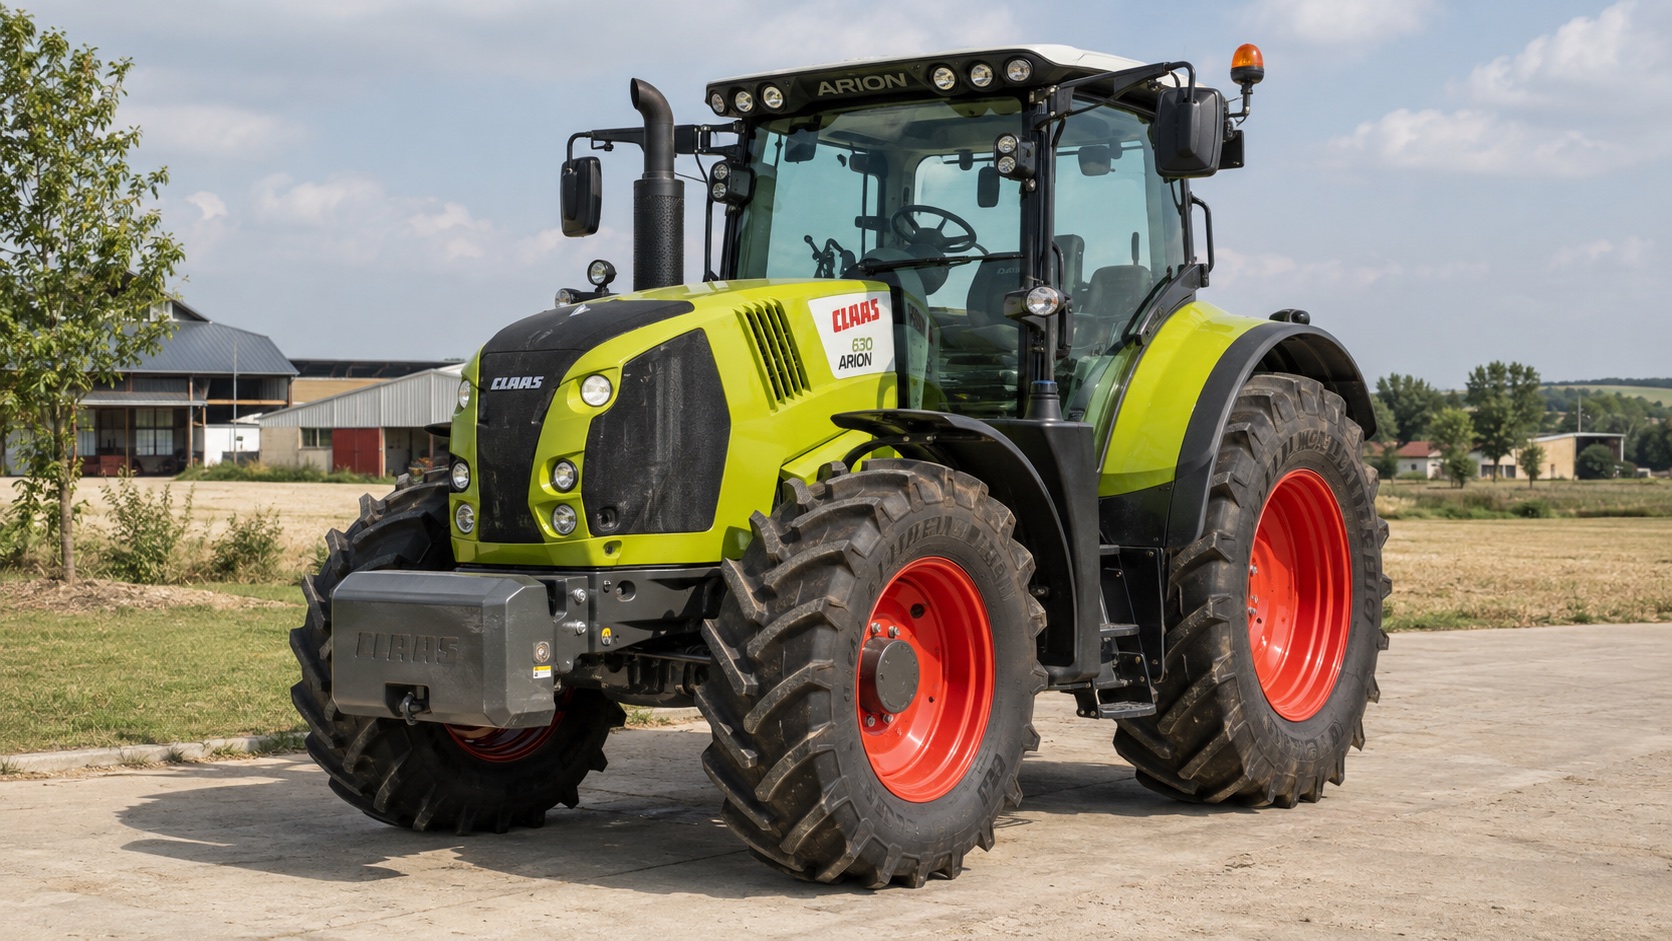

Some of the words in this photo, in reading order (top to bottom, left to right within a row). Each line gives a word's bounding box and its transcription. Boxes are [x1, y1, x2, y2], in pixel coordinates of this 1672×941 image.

[817, 73, 908, 96] ARION
[832, 297, 880, 333] CLAAS
[852, 336, 873, 352] 630
[838, 352, 873, 370] ARION
[490, 375, 545, 391] CLAAS
